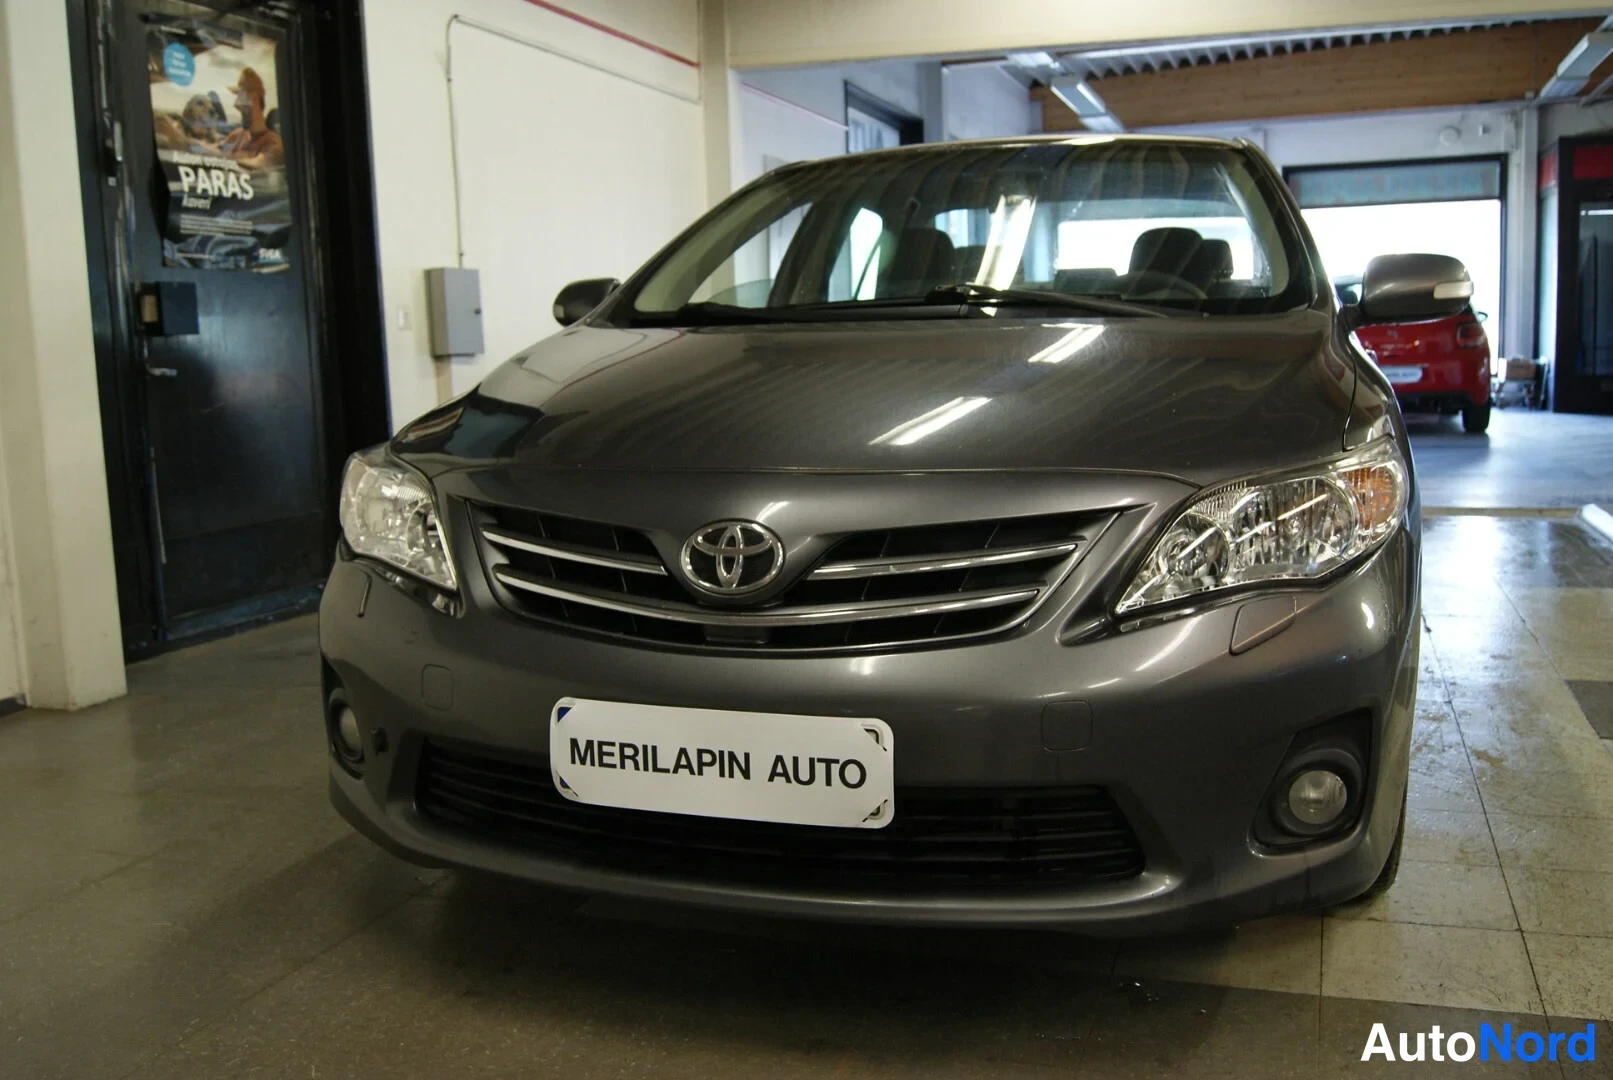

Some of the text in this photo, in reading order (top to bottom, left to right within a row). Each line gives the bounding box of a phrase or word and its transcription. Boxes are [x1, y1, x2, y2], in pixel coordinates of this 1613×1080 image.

[178, 165, 254, 200] PARAS
[569, 738, 867, 789] MERILAPIN AUTO
